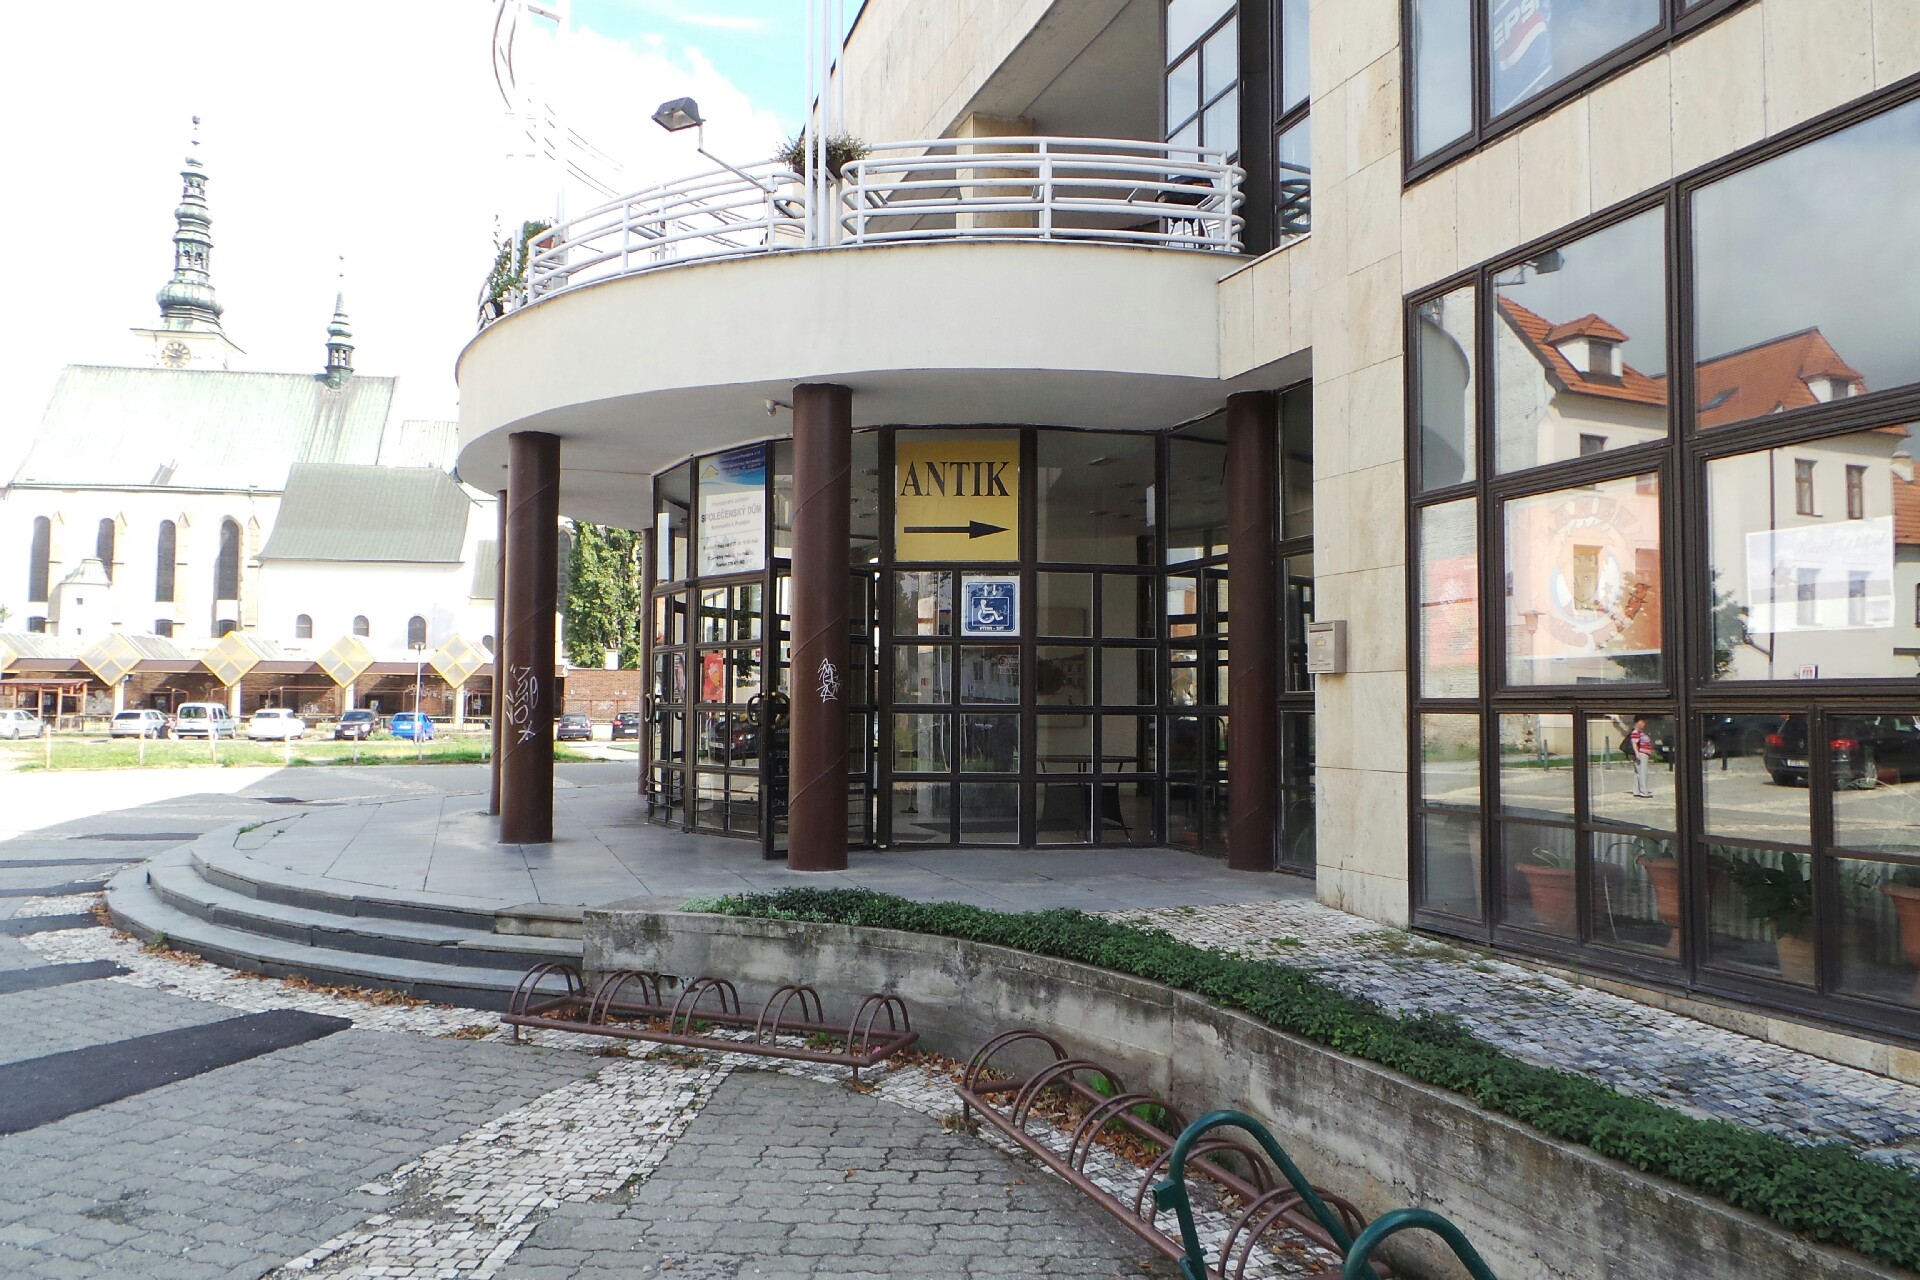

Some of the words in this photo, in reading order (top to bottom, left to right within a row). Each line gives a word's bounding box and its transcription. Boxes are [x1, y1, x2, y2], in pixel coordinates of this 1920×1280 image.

[900, 461, 1010, 496] ANTIK
[701, 505, 745, 523] SPOLEČENSKÝ
[747, 504, 762, 515] DŮM
